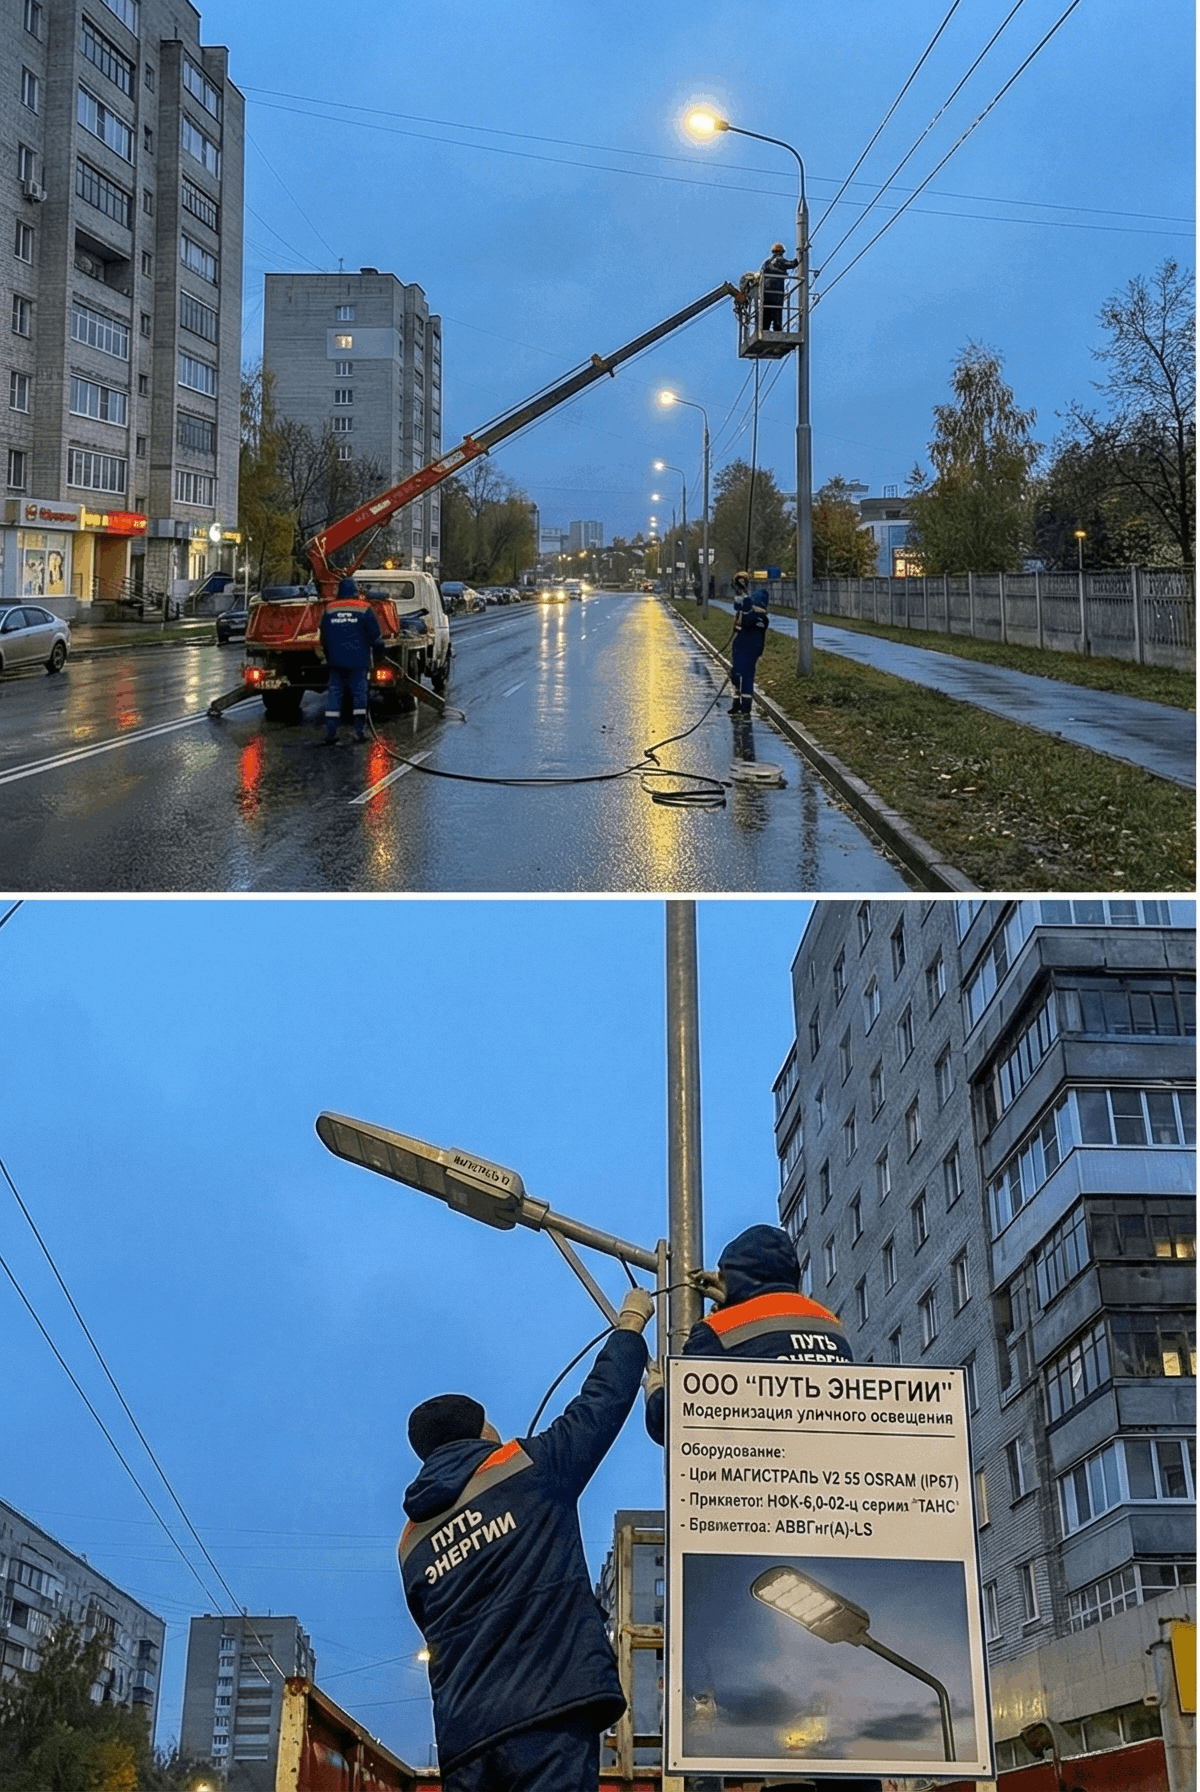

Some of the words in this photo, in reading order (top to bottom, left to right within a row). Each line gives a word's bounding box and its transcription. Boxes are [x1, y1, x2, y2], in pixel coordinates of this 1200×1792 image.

[790, 1333, 838, 1351] ПУТЬ
[683, 1372, 738, 1395] ООО
[828, 1378, 952, 1402] ЭНЕРГИИ"
[682, 1402, 793, 1421] Модернизация
[797, 1408, 867, 1424] уличного
[870, 1411, 953, 1426] освещения
[721, 1467, 819, 1484] МАГИСТРАЛЬ
[822, 1470, 840, 1485] V2
[844, 1471, 860, 1485] 55
[864, 1472, 916, 1487] OSRAM
[920, 1474, 959, 1492] (IP67)
[431, 1509, 483, 1553] ПУТЬ
[424, 1511, 517, 1585] ЭНЕРГИИ
